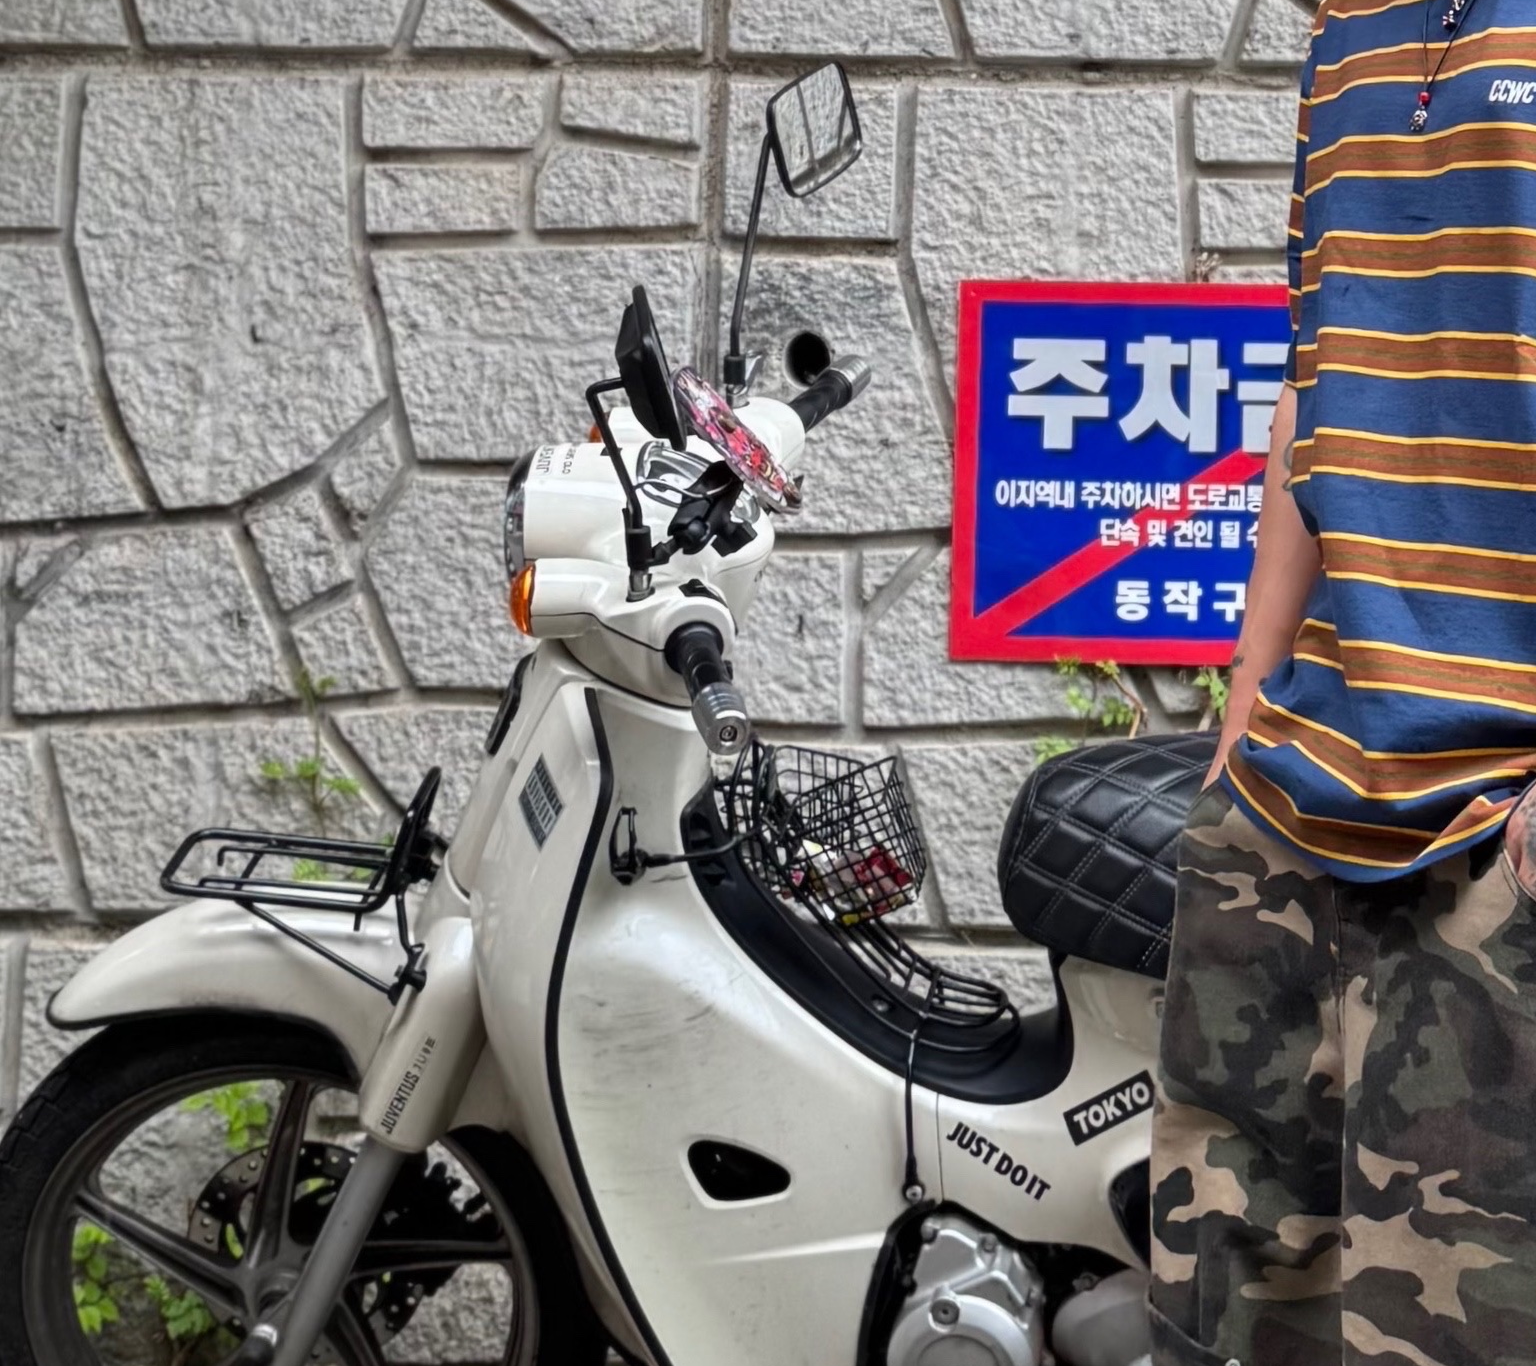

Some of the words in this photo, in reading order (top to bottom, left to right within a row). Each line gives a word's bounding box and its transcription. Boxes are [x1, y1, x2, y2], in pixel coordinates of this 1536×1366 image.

[995, 479, 1075, 508] 이지역내
[1081, 481, 1181, 510] 주차하시면
[1100, 518, 1140, 547] 단속
[1147, 519, 1167, 548] 및
[1173, 519, 1213, 549] 견인
[380, 1070, 420, 1135] JUVENTUS
[1073, 1081, 1150, 1135] TOKYO
[946, 1121, 1000, 1166] JUST
[993, 1152, 1029, 1187] DO
[1024, 1174, 1052, 1202] IT
